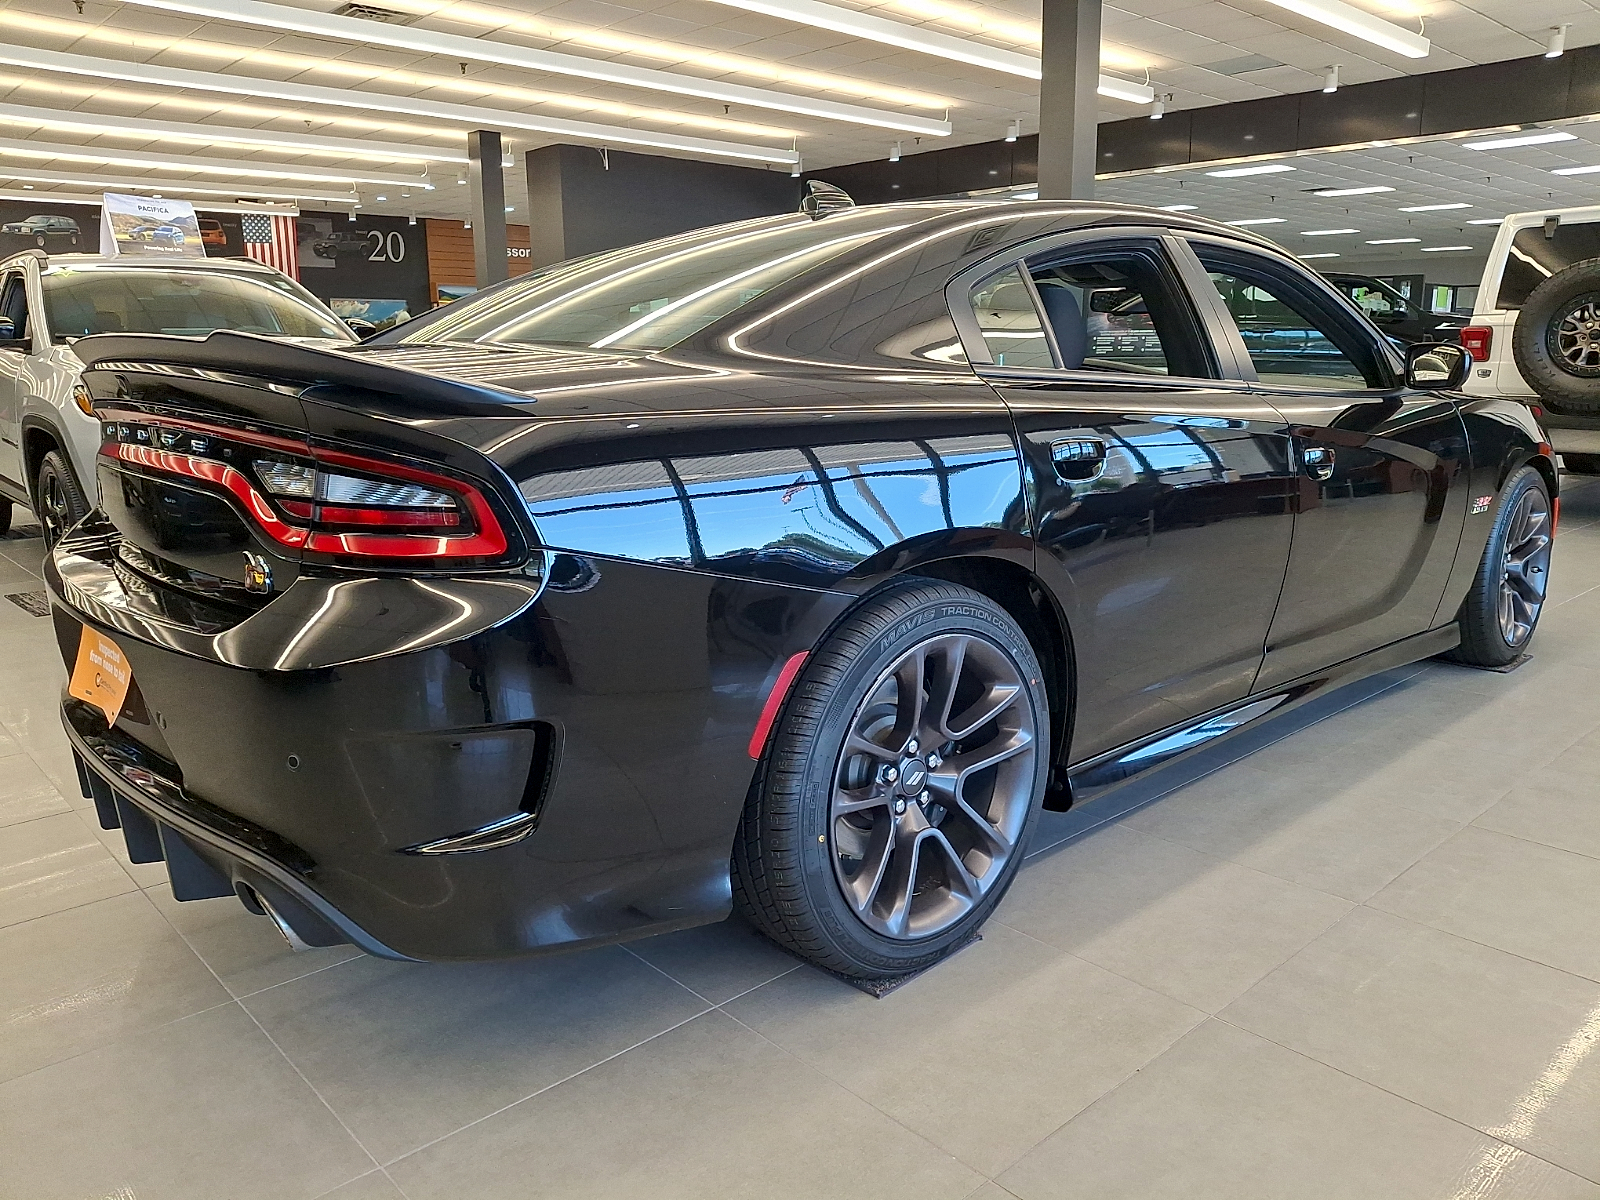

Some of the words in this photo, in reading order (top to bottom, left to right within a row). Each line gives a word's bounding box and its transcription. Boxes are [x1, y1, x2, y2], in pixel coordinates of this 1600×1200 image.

[137, 205, 170, 214] PACIFICA
[367, 230, 405, 263] 20
[106, 425, 209, 453] DODGE
[880, 608, 936, 654] MAVIS
[941, 606, 992, 622] TRACTION
[992, 616, 1029, 656] CONTROL
